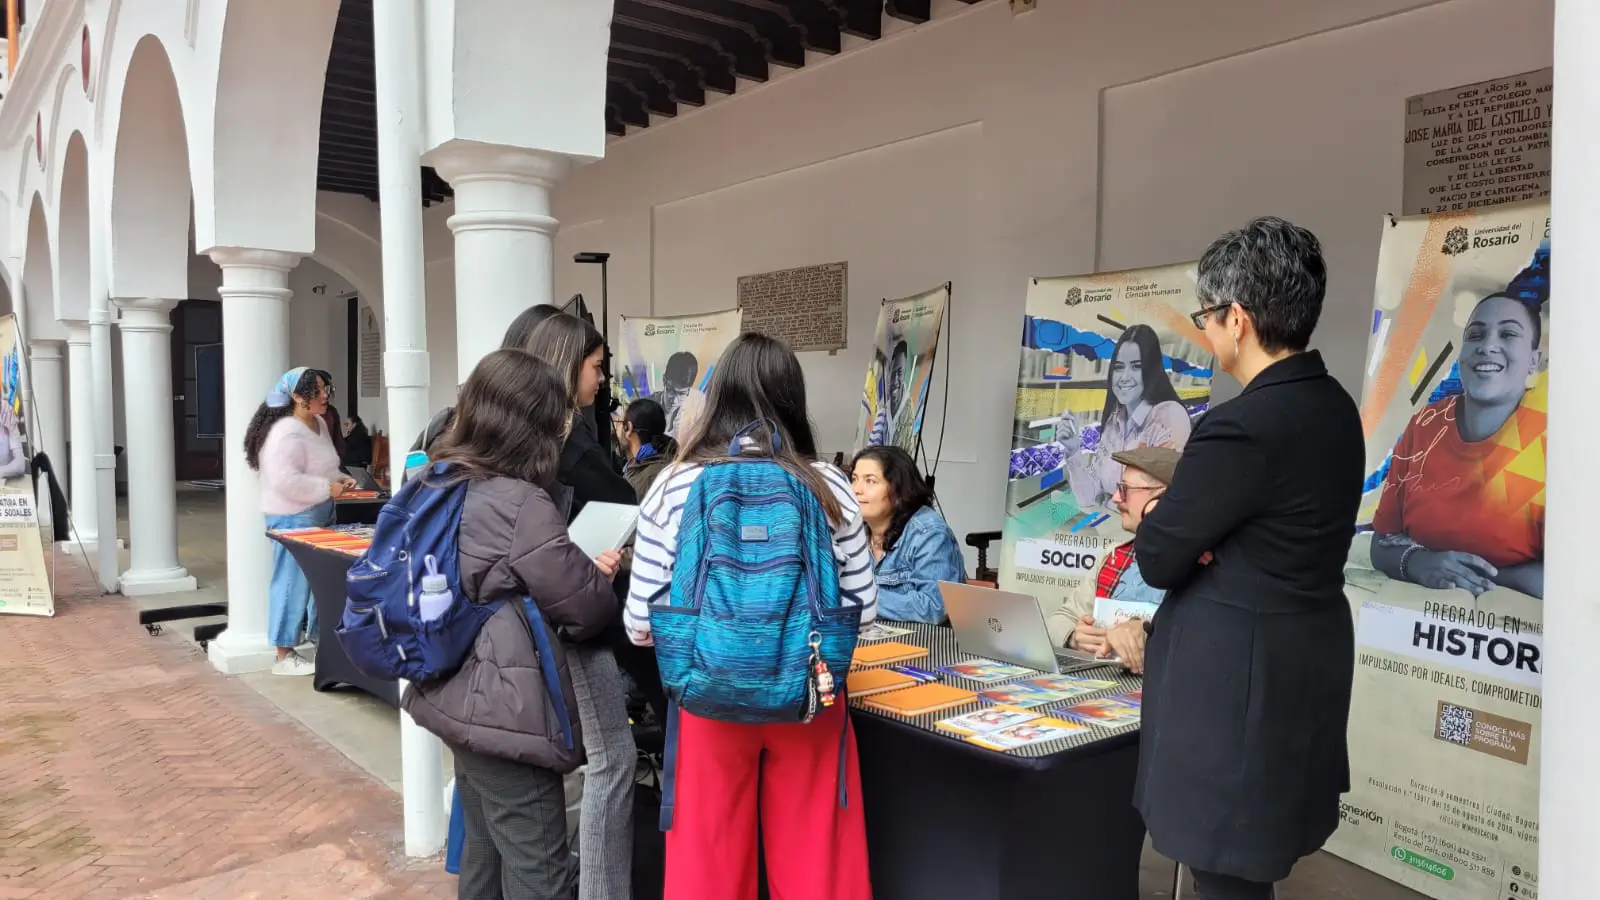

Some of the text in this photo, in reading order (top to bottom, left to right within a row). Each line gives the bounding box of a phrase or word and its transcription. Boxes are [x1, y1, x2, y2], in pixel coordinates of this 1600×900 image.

[1457, 90, 1478, 99] CIEN
[1484, 84, 1509, 94] AÑOS
[1424, 106, 1446, 116] FALTA
[1464, 98, 1485, 108] ESTE
[1489, 89, 1531, 102] COLEGIO
[1484, 98, 1537, 113] REPUBLICA
[1405, 104, 1552, 143] JOSE MARIA DEL CASTILLO Y
[1432, 140, 1448, 148] LUZ
[1469, 132, 1487, 141] LOS
[1467, 141, 1492, 150] GRAN
[1499, 132, 1548, 145] COLOMBIA
[1426, 151, 1489, 167] CONSERVADOR
[1492, 155, 1521, 165] LEYES
[1489, 163, 1533, 176] LIBERTAD
[1429, 185, 1446, 194] QUE
[1465, 179, 1495, 188] COSTO
[1485, 183, 1540, 196] CARTAGENA
[1468, 195, 1517, 208] DICIEMBRE
[1475, 224, 1509, 235] Universidad
[1473, 232, 1519, 248] Rosario
[1084, 293, 1111, 302] Rosario
[19, 498, 28, 506] EN
[1055, 533, 1098, 548] PREGRADO
[1016, 572, 1045, 584] IMPULSADOS
[1046, 576, 1056, 585] POR
[1424, 600, 1496, 630] PREGRADO
[1503, 615, 1520, 635] EN
[1413, 621, 1542, 674] HISTOR
[1359, 653, 1542, 709] IMPULSADOS POR IDEALES, COMPROMETID
[1475, 728, 1498, 740] SOBRE
[1476, 721, 1508, 735] CONOCE
[1474, 734, 1516, 752] PROGRAMA
[1446, 793, 1480, 810] semestres
[1487, 805, 1513, 821] Ciudad:
[1348, 817, 1359, 825] Call
[1432, 800, 1441, 808] del
[1453, 807, 1460, 815] de
[1463, 810, 1485, 824] agosto
[1487, 819, 1495, 828] de
[1517, 830, 1539, 844] vigen
[1394, 832, 1411, 844] Resto
